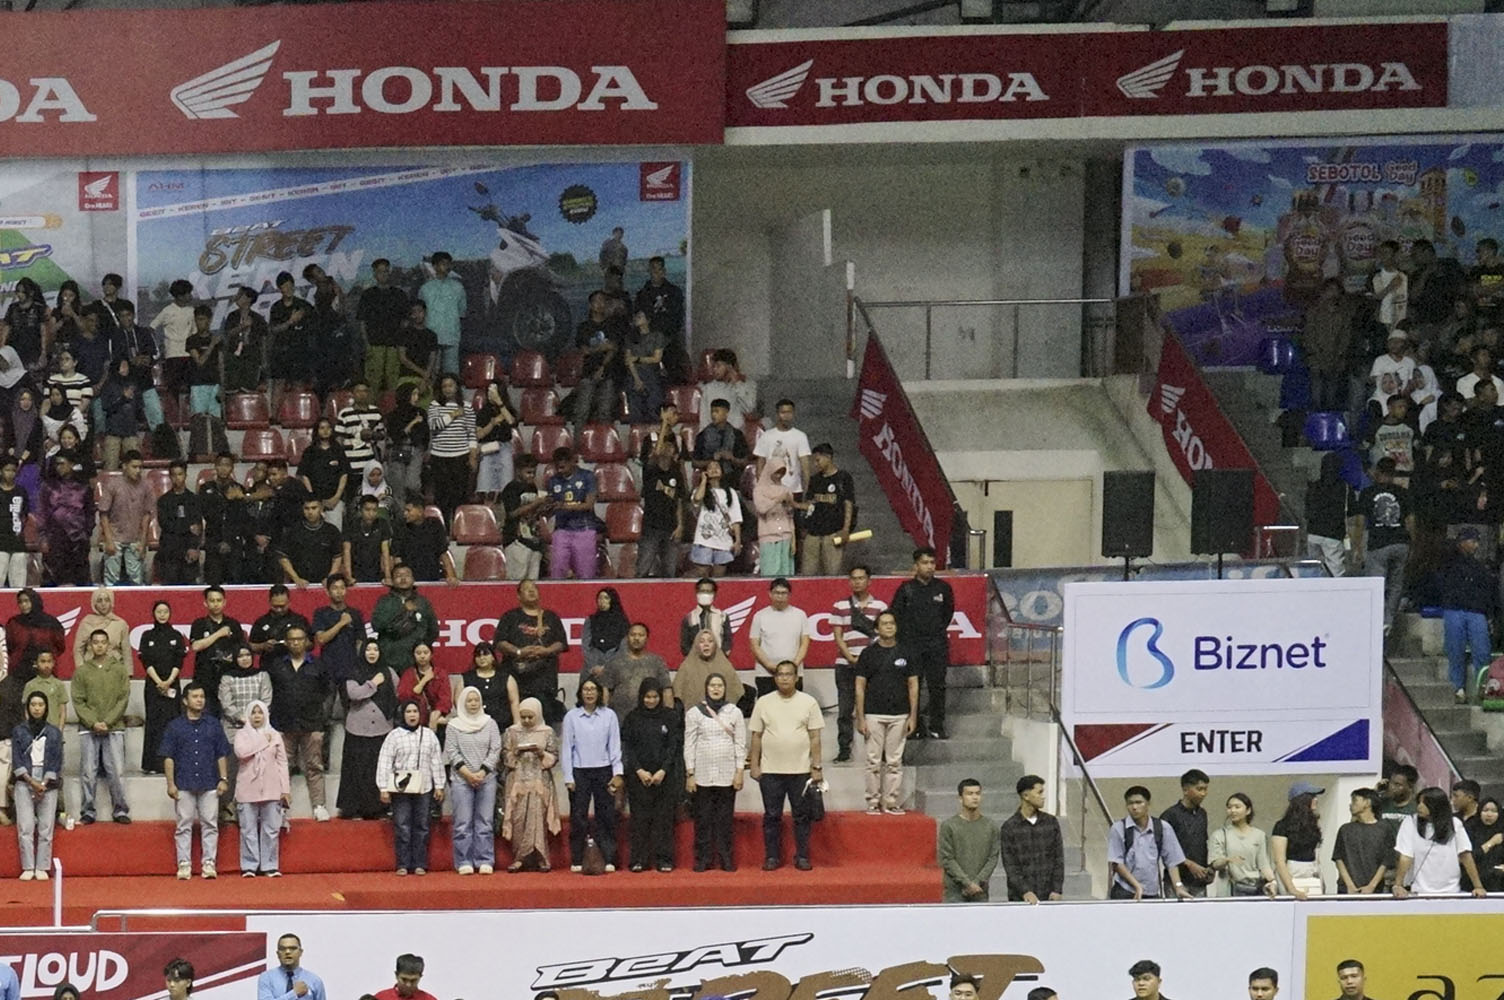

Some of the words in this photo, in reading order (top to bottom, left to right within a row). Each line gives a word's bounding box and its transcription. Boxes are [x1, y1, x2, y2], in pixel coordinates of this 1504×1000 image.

[282, 65, 659, 117] HONDA
[815, 72, 1050, 108] HONDA
[1185, 61, 1422, 98] HONDA
[872, 421, 936, 549] HONDA
[1194, 635, 1328, 671] Biznet
[1180, 729, 1263, 754] ENTER
